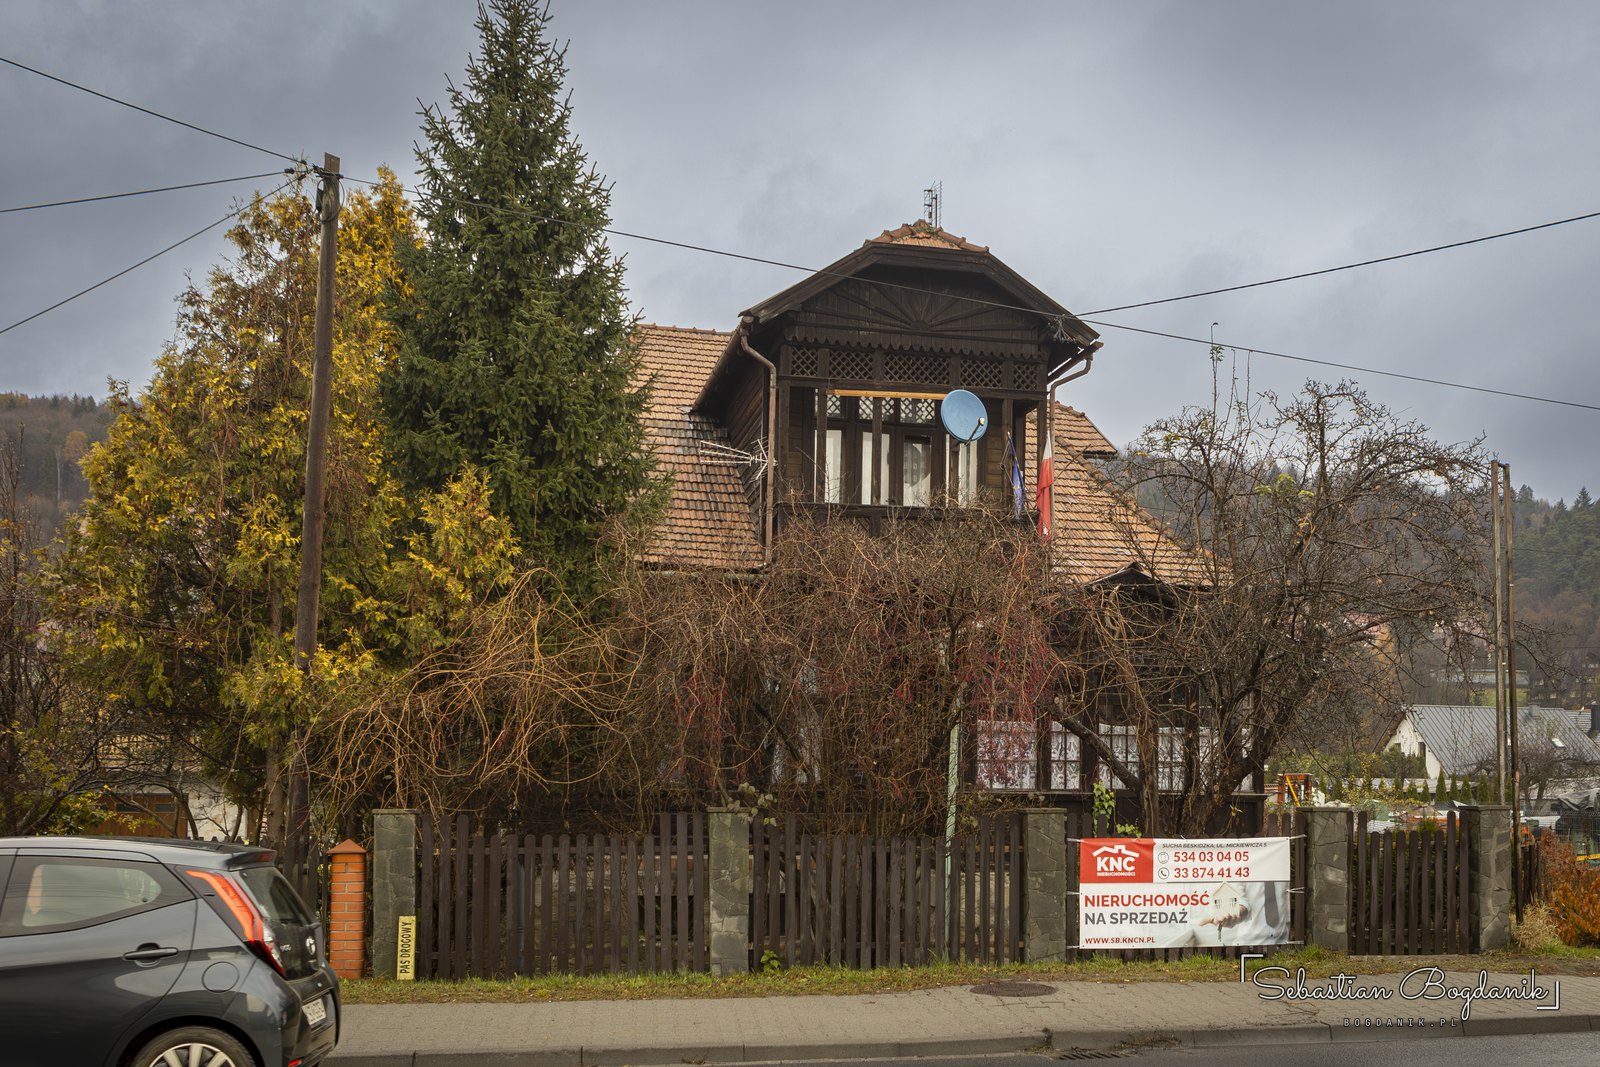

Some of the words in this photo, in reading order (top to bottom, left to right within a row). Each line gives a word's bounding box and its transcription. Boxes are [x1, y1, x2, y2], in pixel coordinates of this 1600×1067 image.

[1096, 856, 1136, 872] KNC
[1174, 851, 1196, 862] 534
[1198, 851, 1214, 862] 03
[1216, 851, 1232, 862] 04
[1234, 851, 1249, 862] 05
[1174, 867, 1189, 878] 33
[1192, 867, 1215, 878] 874
[1217, 867, 1232, 878] 41
[1235, 867, 1250, 878] 43
[1084, 890, 1210, 907] NIERUCHOMOŚĆ
[1084, 912, 1106, 925] NA
[1109, 908, 1188, 925] SPRZEDAŻ
[400, 921, 412, 958] DROGOWY
[1085, 936, 1156, 944] WWW.SB.KNCN.PL
[400, 960, 411, 974] PAS
